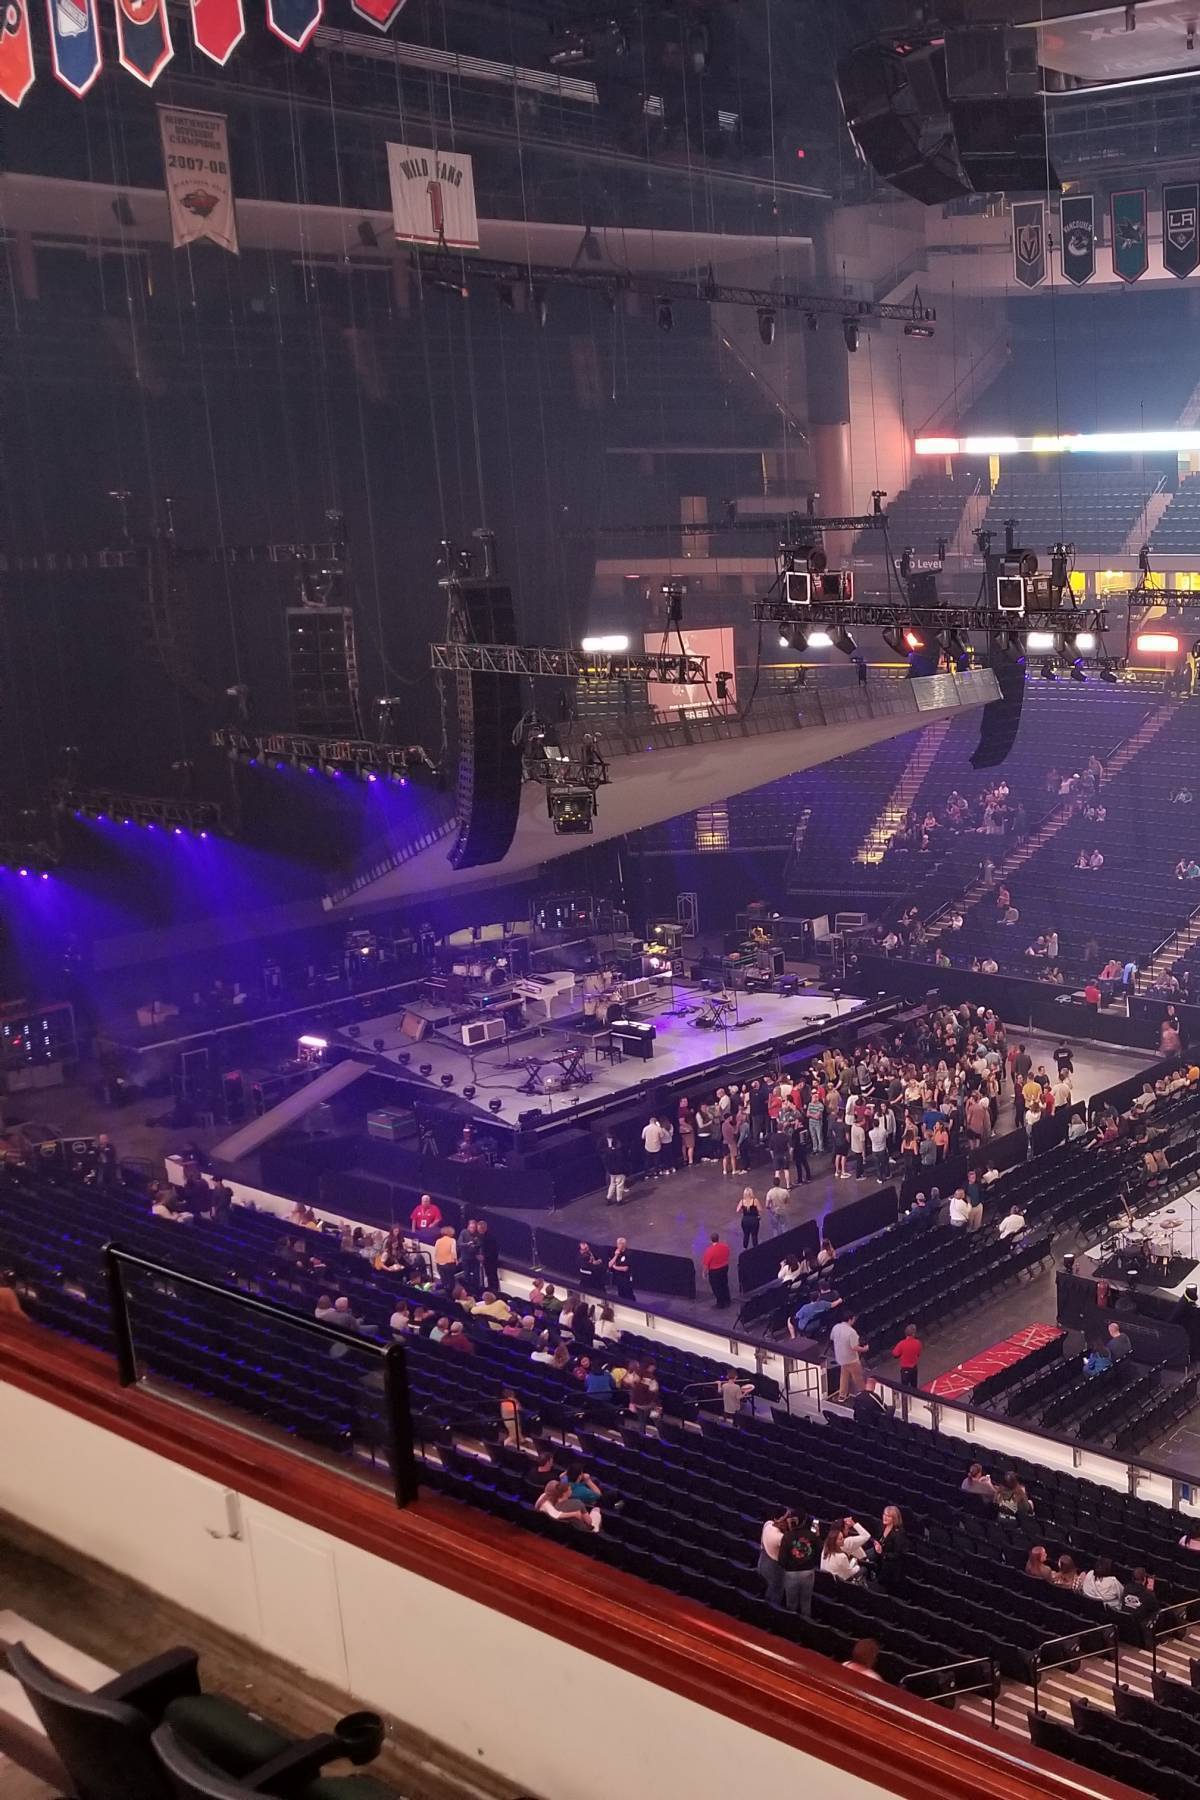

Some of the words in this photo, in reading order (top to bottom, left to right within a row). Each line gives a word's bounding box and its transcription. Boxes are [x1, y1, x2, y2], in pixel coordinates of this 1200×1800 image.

[168, 154, 227, 175] 2007-08
[400, 158, 429, 180] WILD
[435, 160, 463, 188] FANS
[427, 181, 444, 232] 1
[1169, 209, 1194, 227] LA
[917, 559, 942, 569] Level
